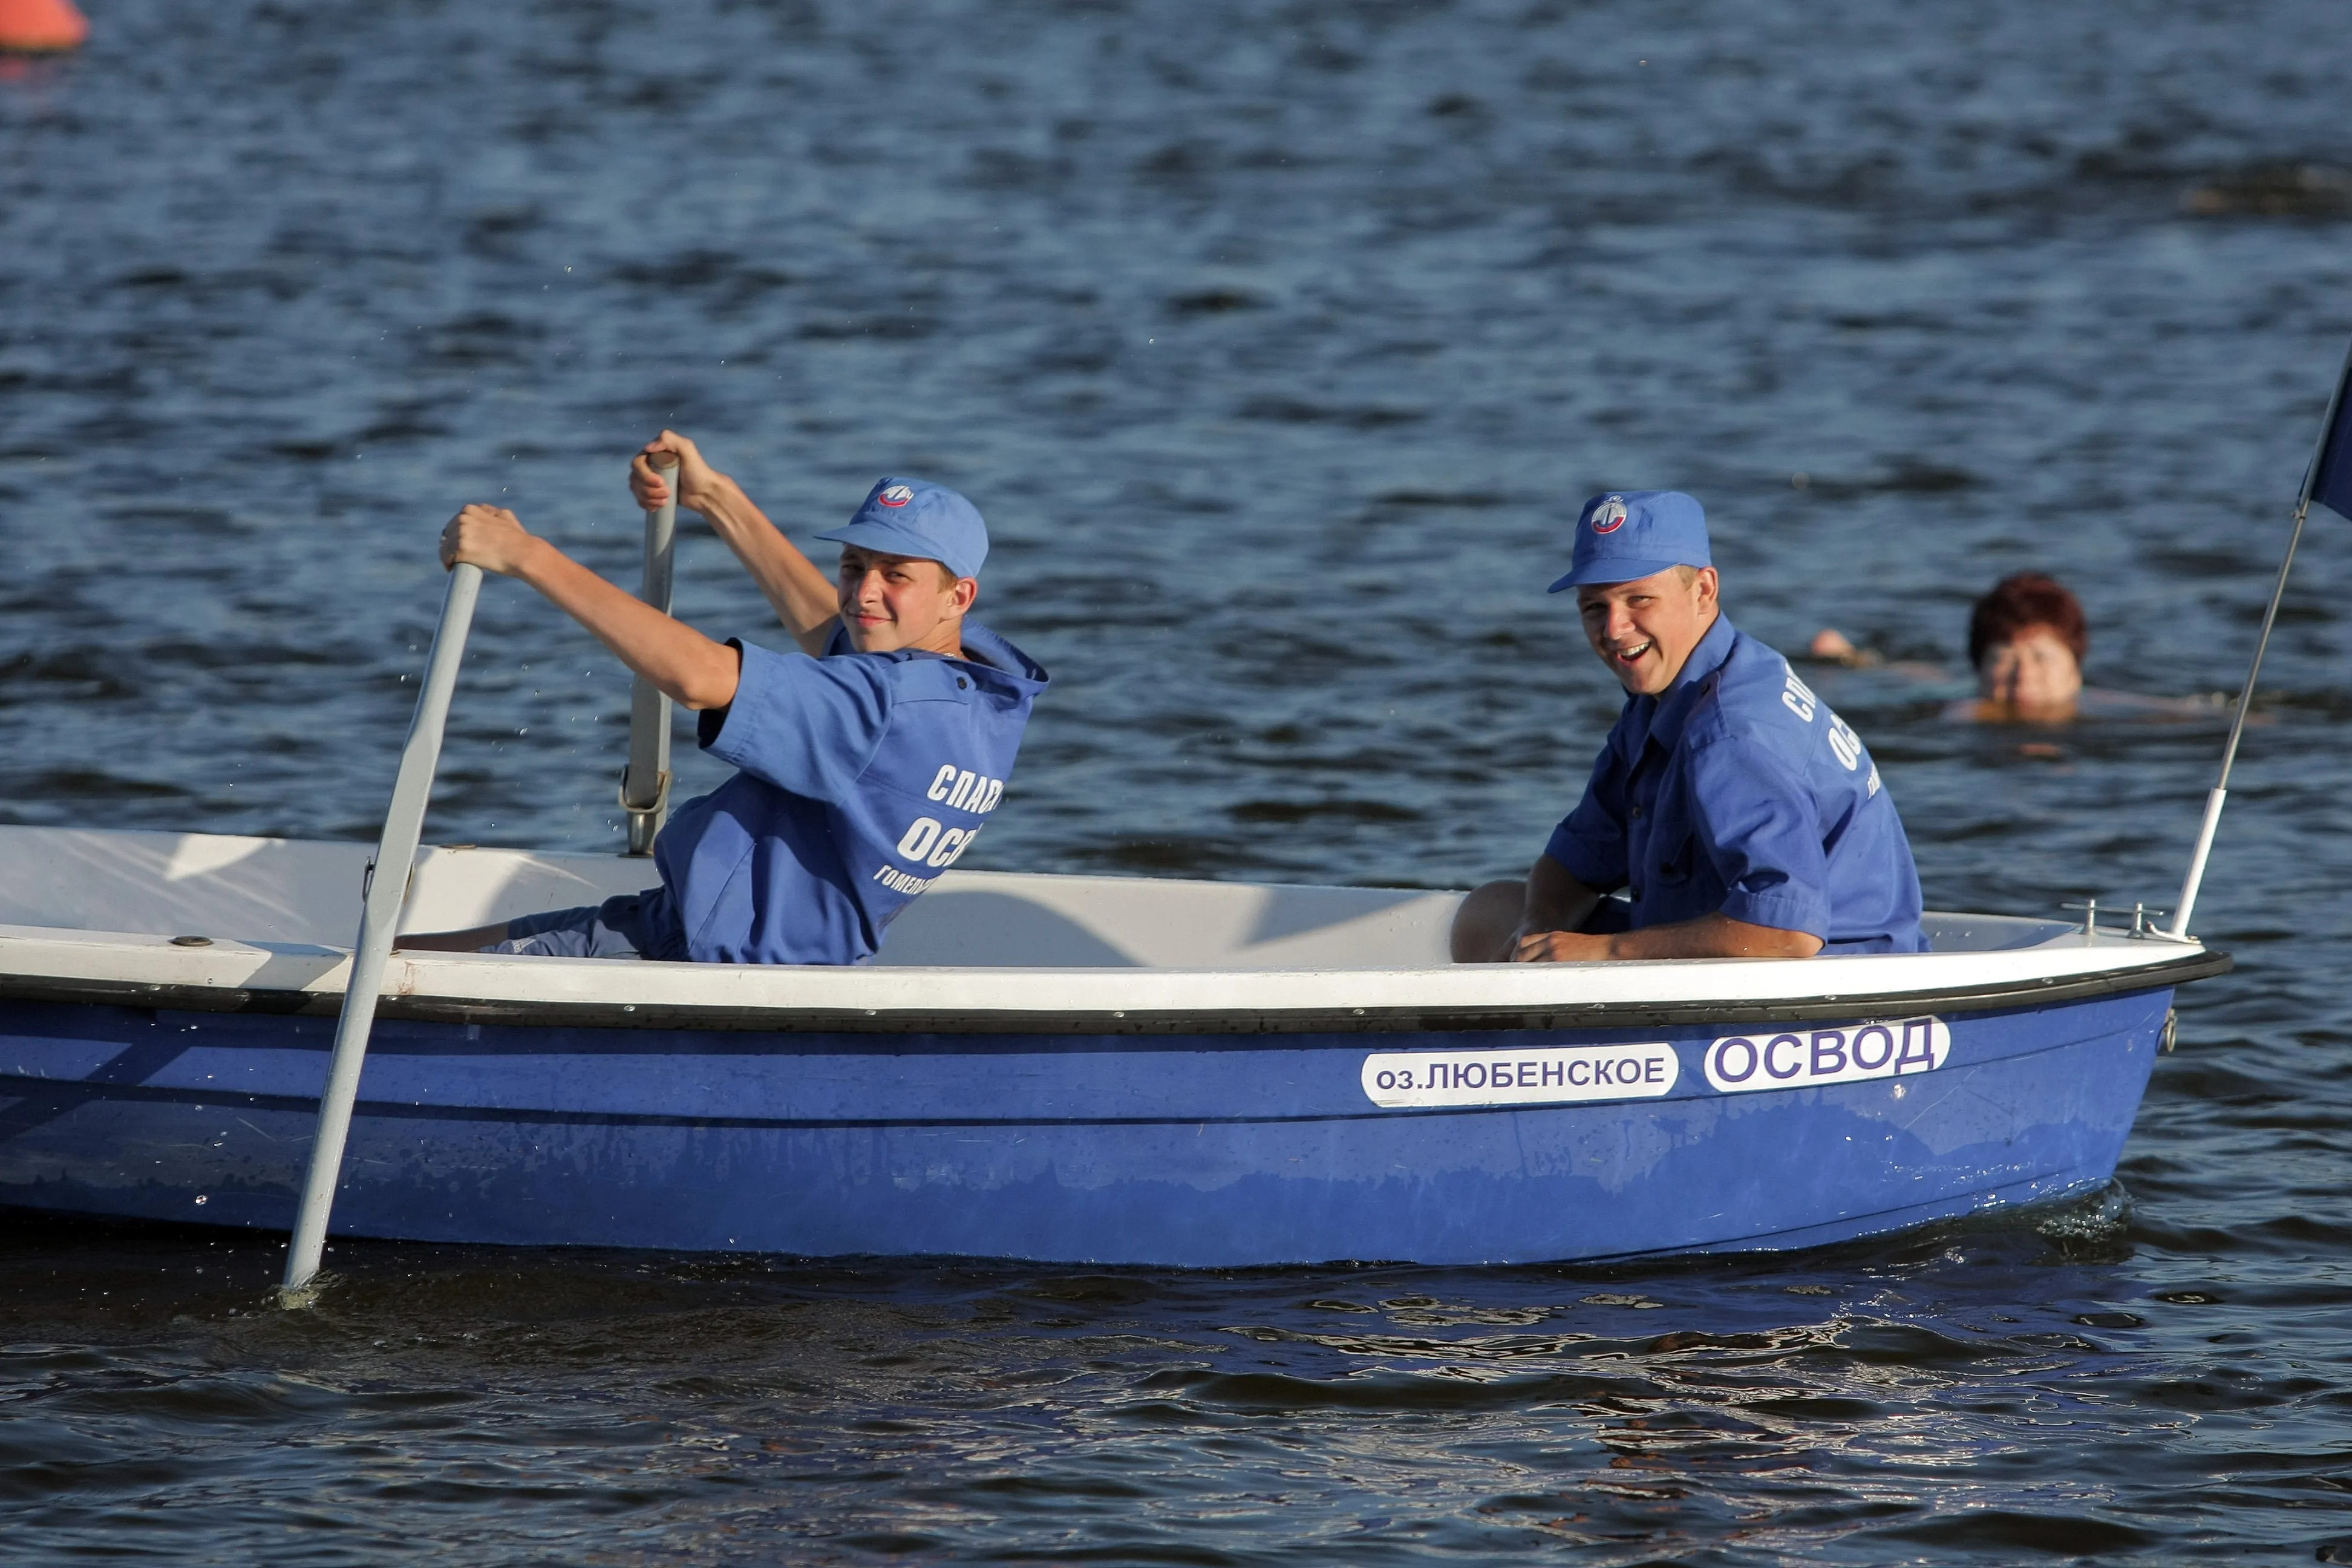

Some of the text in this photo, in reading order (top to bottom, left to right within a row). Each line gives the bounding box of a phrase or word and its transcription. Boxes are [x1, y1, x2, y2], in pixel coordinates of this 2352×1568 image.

[1828, 714, 1862, 771] ОС
[926, 763, 1004, 814] СПАС
[896, 817, 984, 867] ОСВ
[1376, 1056, 1665, 1090] оз.ЛЮБЕНСКОЕ
[1714, 1017, 1935, 1082] ОСВОД
